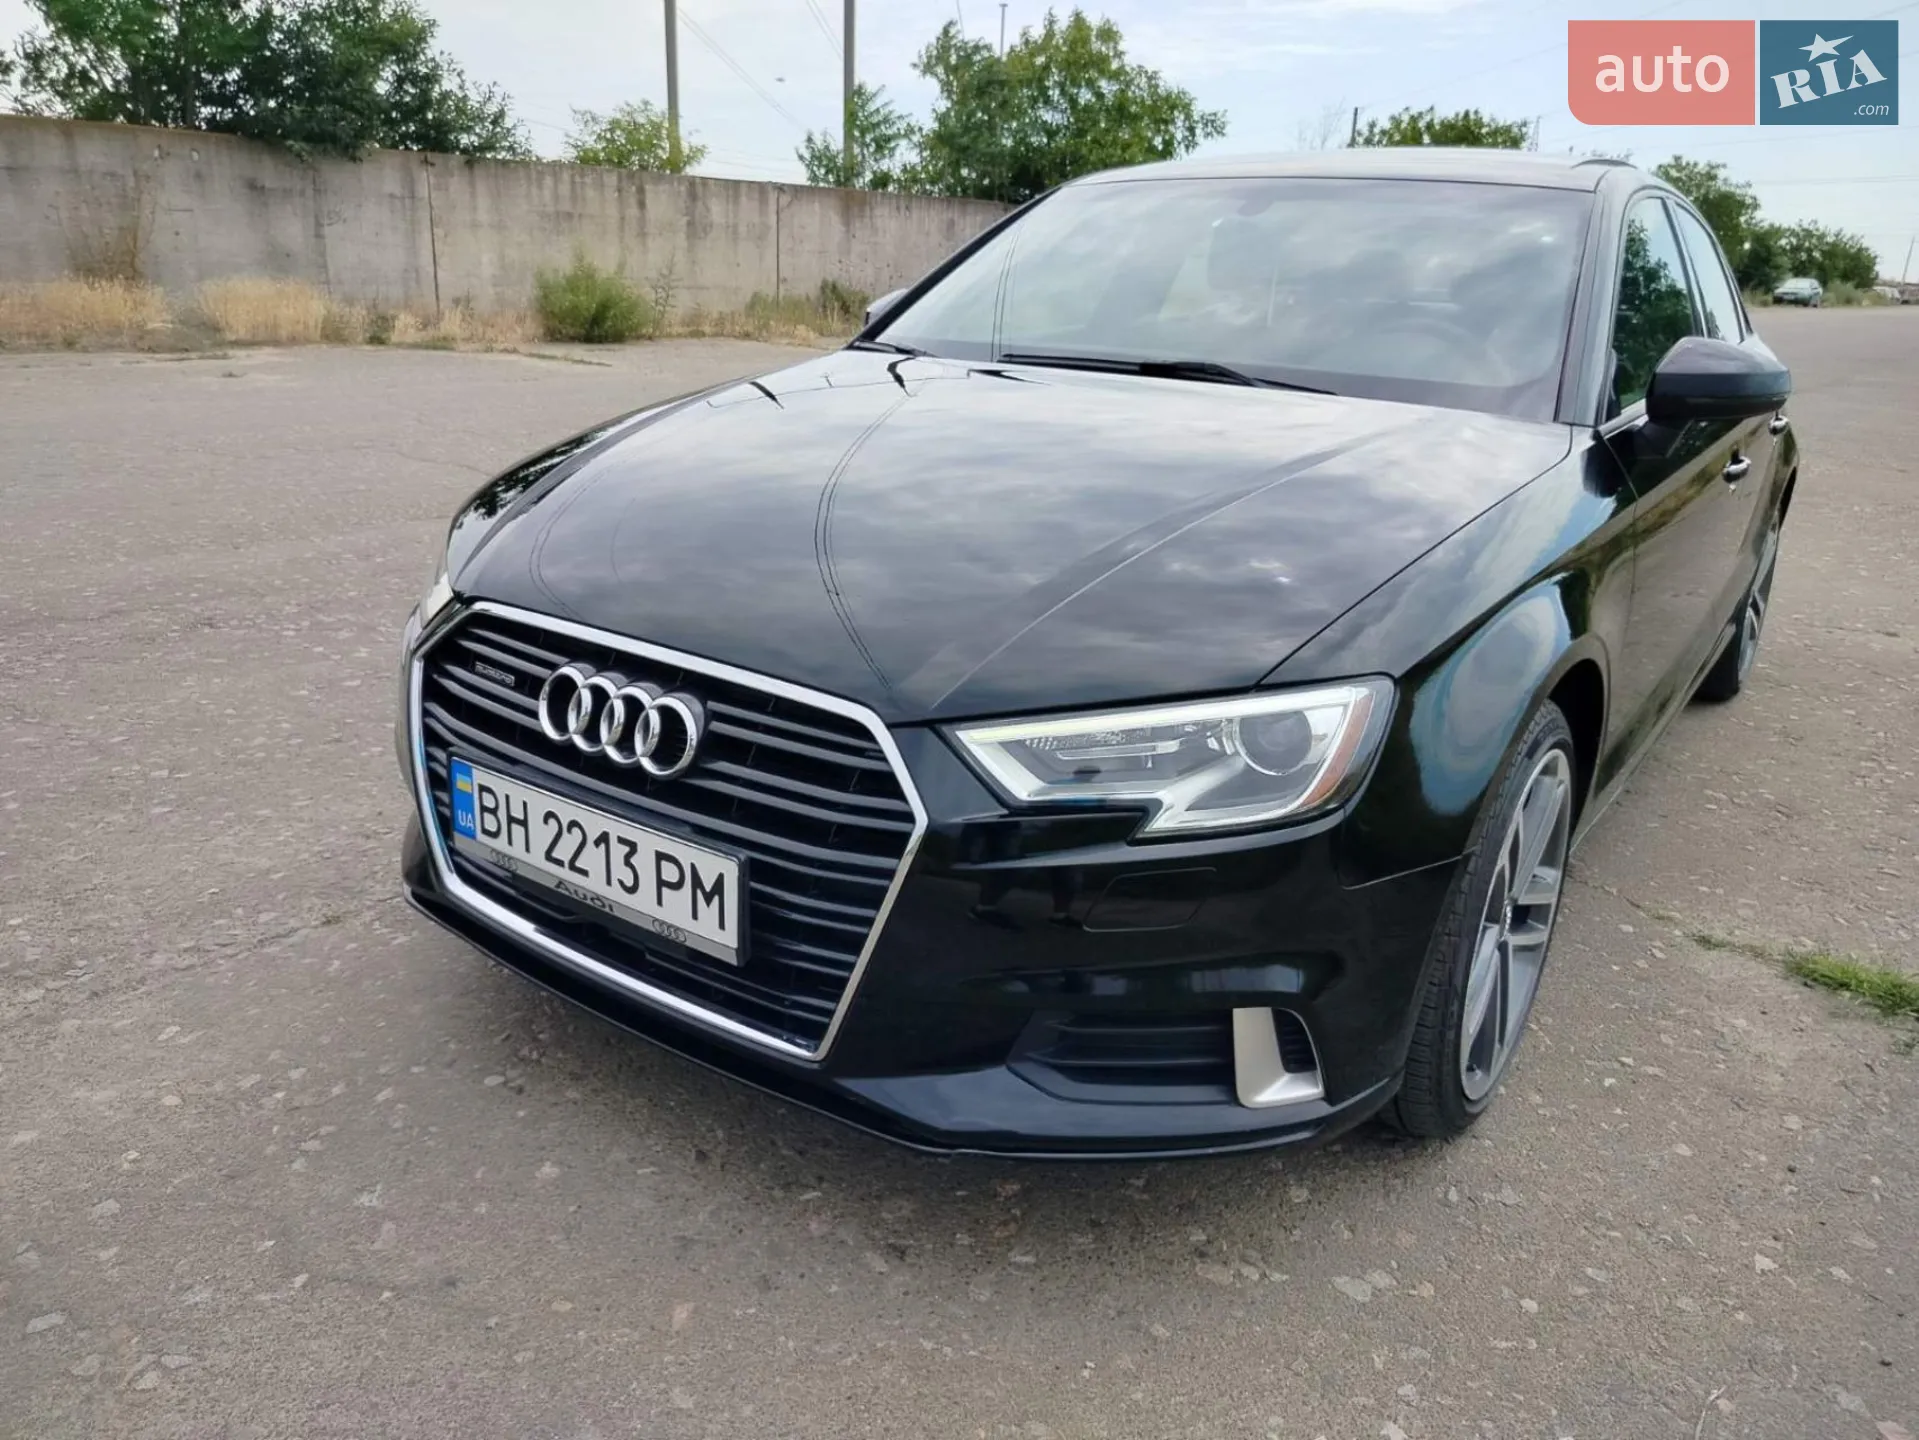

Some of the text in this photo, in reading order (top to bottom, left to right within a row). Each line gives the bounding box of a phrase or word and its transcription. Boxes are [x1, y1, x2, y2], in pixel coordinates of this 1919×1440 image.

[458, 809, 474, 830] UA
[477, 783, 726, 931] BH 2213 PM
